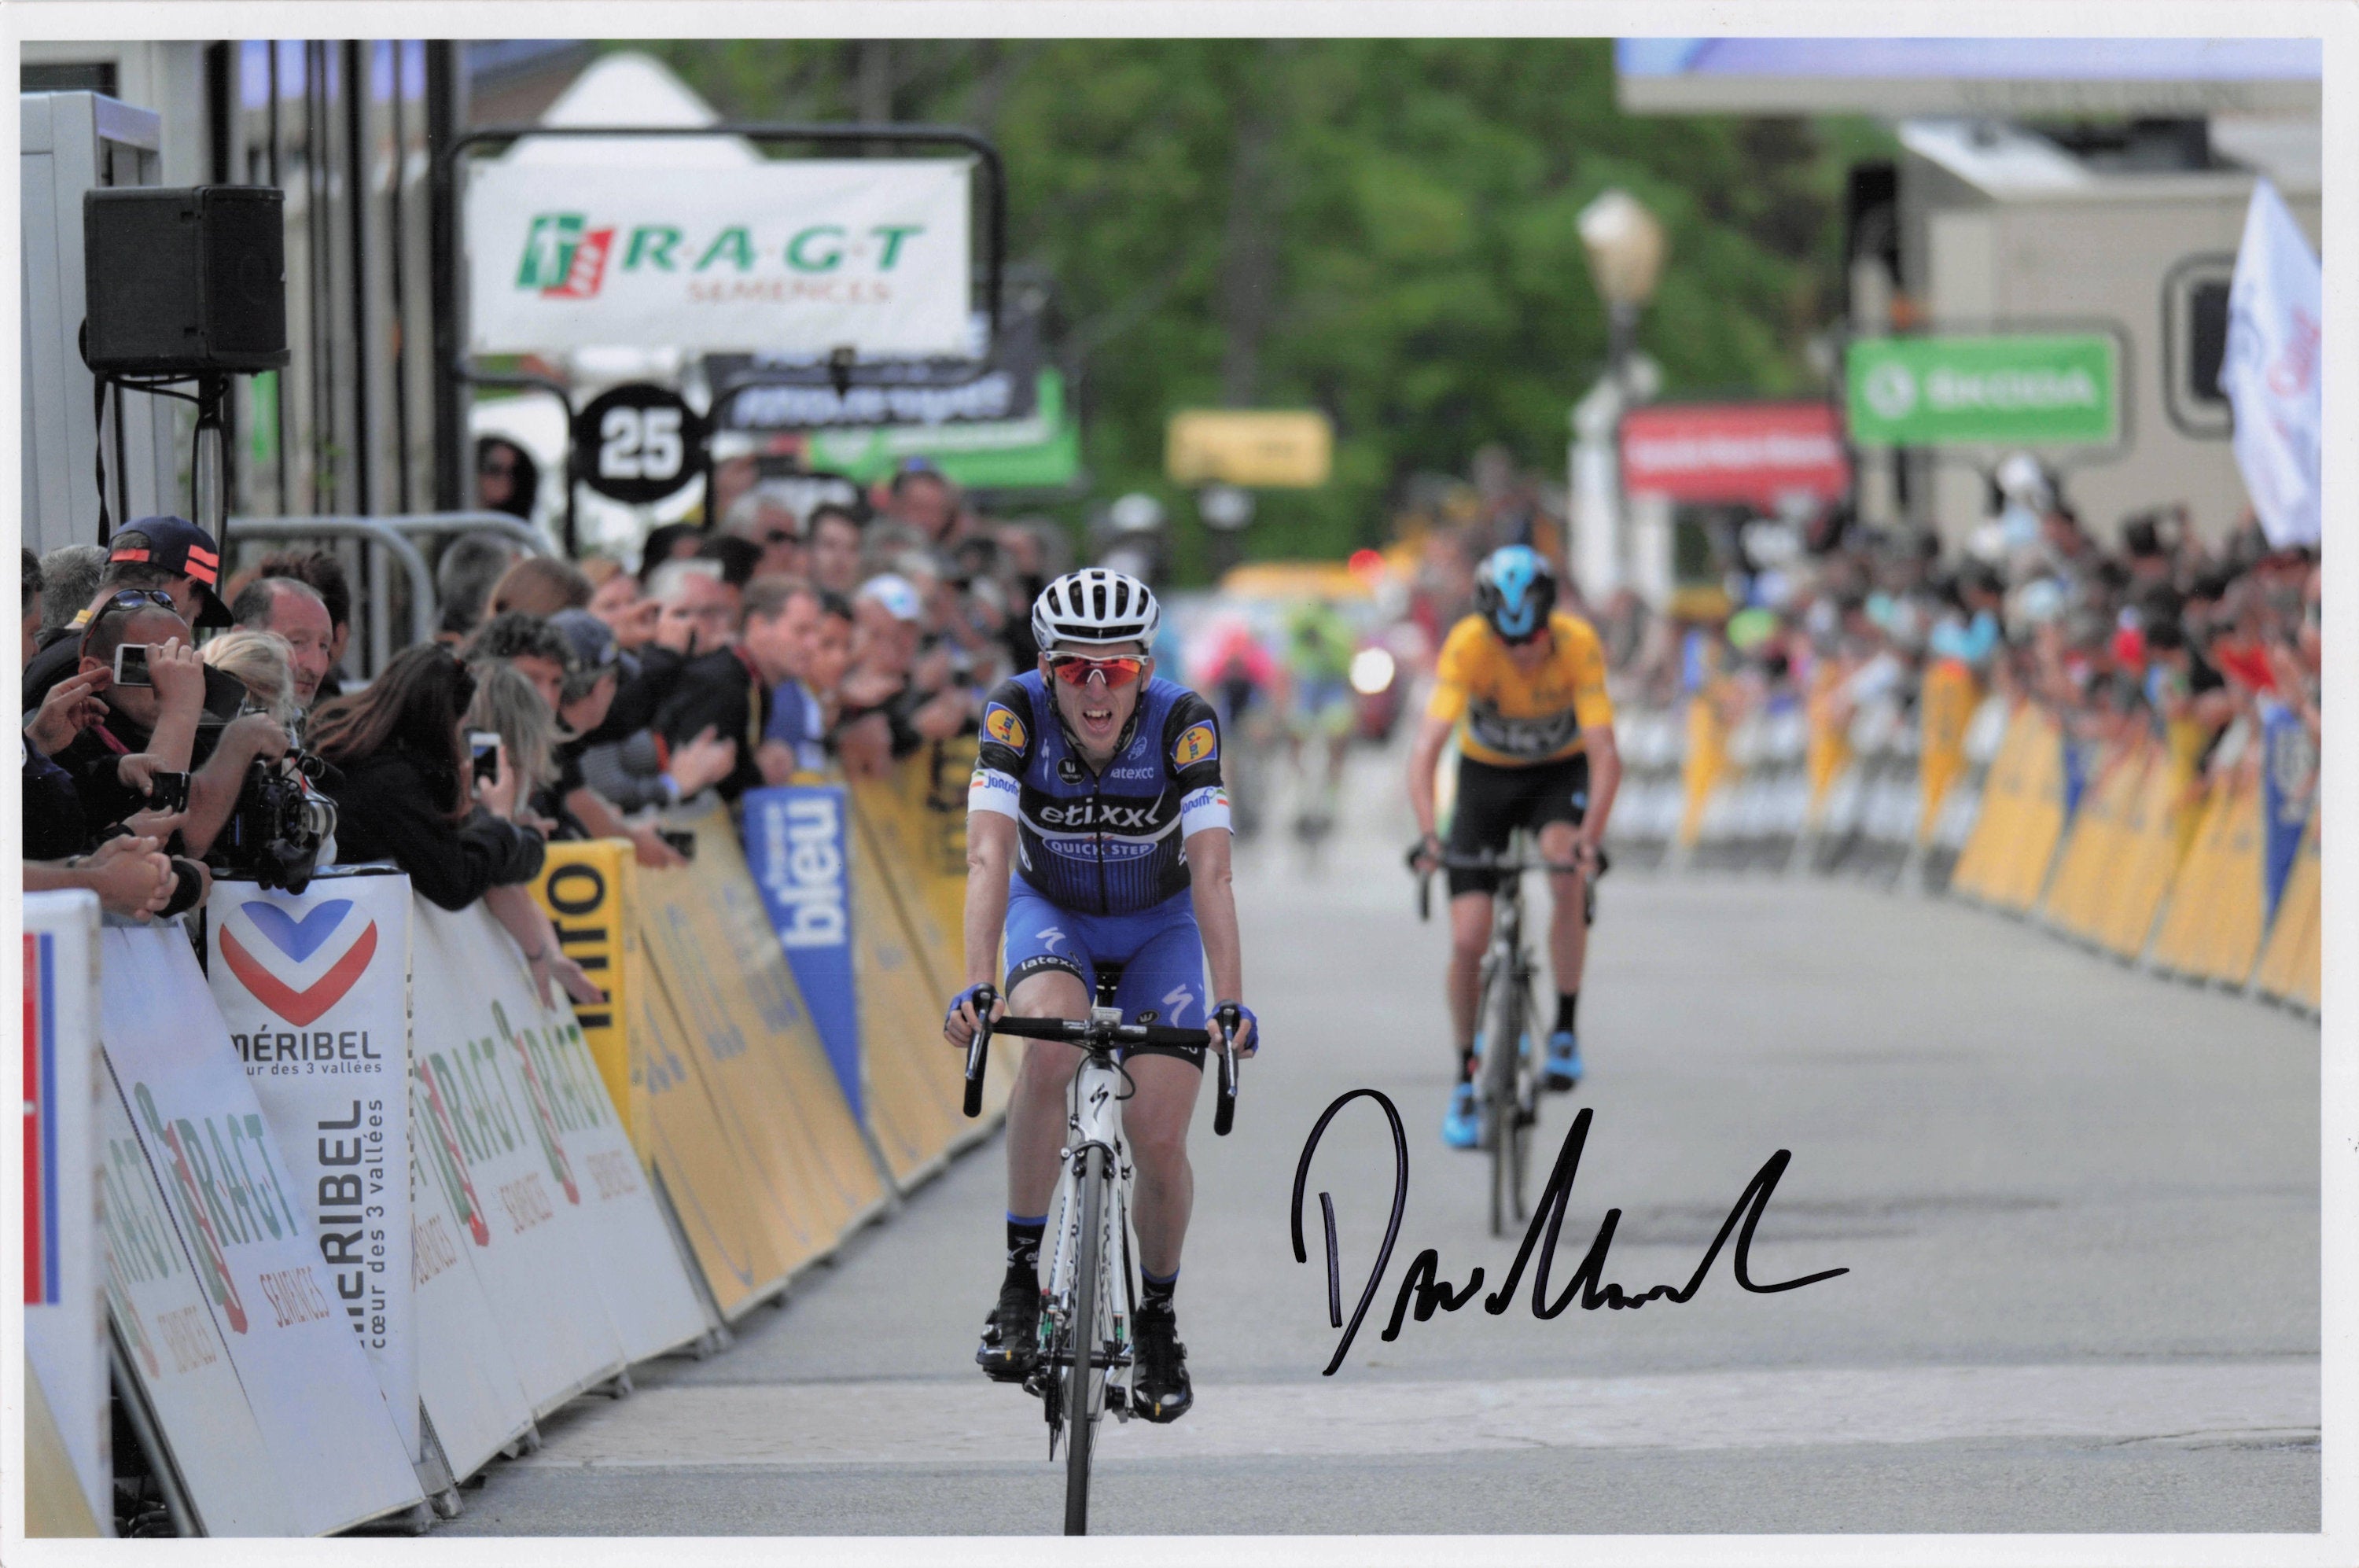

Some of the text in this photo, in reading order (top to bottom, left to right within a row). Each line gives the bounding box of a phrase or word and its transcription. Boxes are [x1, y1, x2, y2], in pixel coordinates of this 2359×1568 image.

[598, 407, 684, 480] 25
[778, 797, 845, 947] bleu
[270, 1062, 300, 1076] des
[306, 1062, 315, 1074] 3
[321, 1059, 383, 1074] vallées
[364, 1099, 384, 1195] vallées
[318, 1100, 365, 1349] RIBEL
[366, 1205, 385, 1219] 3
[366, 1229, 385, 1275] des
[259, 1265, 330, 1328] SEMENCES
